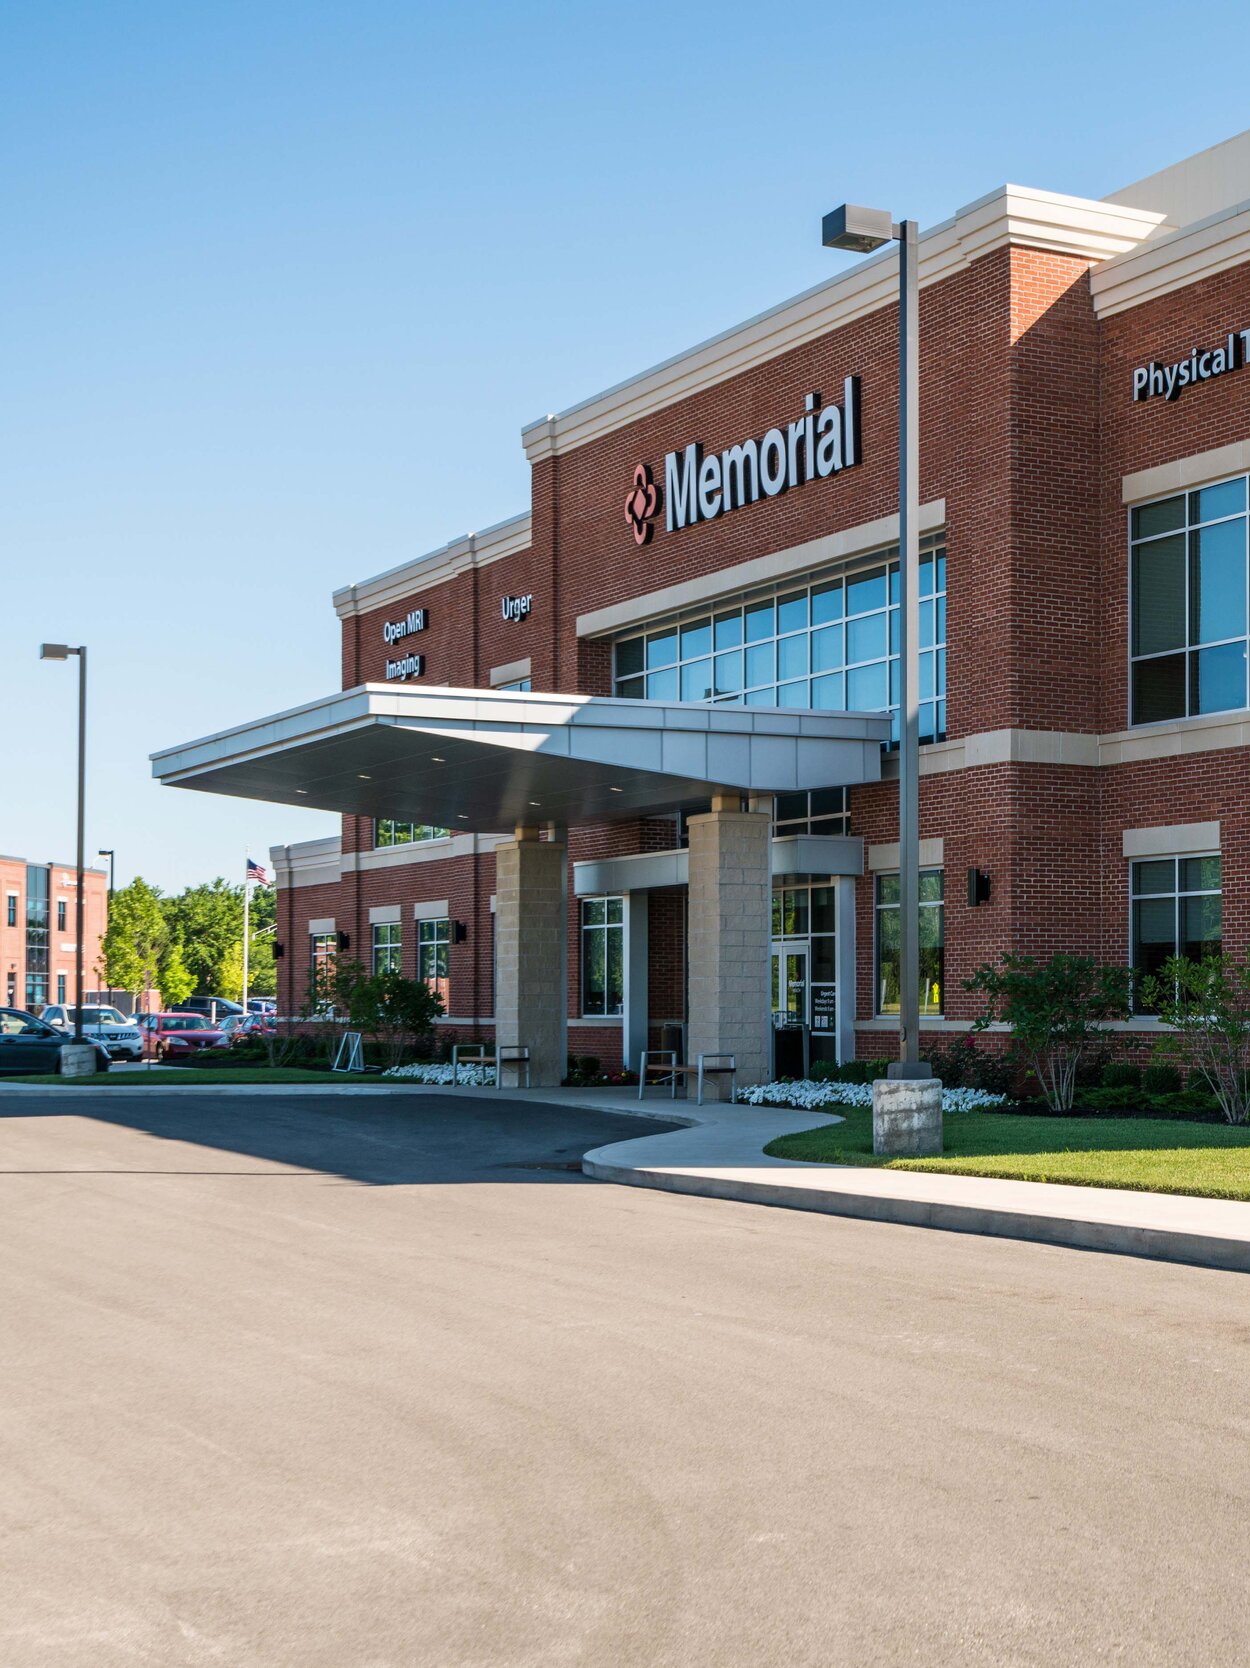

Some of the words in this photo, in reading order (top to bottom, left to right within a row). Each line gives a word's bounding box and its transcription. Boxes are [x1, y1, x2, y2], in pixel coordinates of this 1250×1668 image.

[1133, 333, 1235, 400] Physical
[664, 375, 856, 533] Memorial
[383, 620, 407, 645] Open
[407, 608, 424, 635] MRI
[386, 653, 421, 681] Imaging
